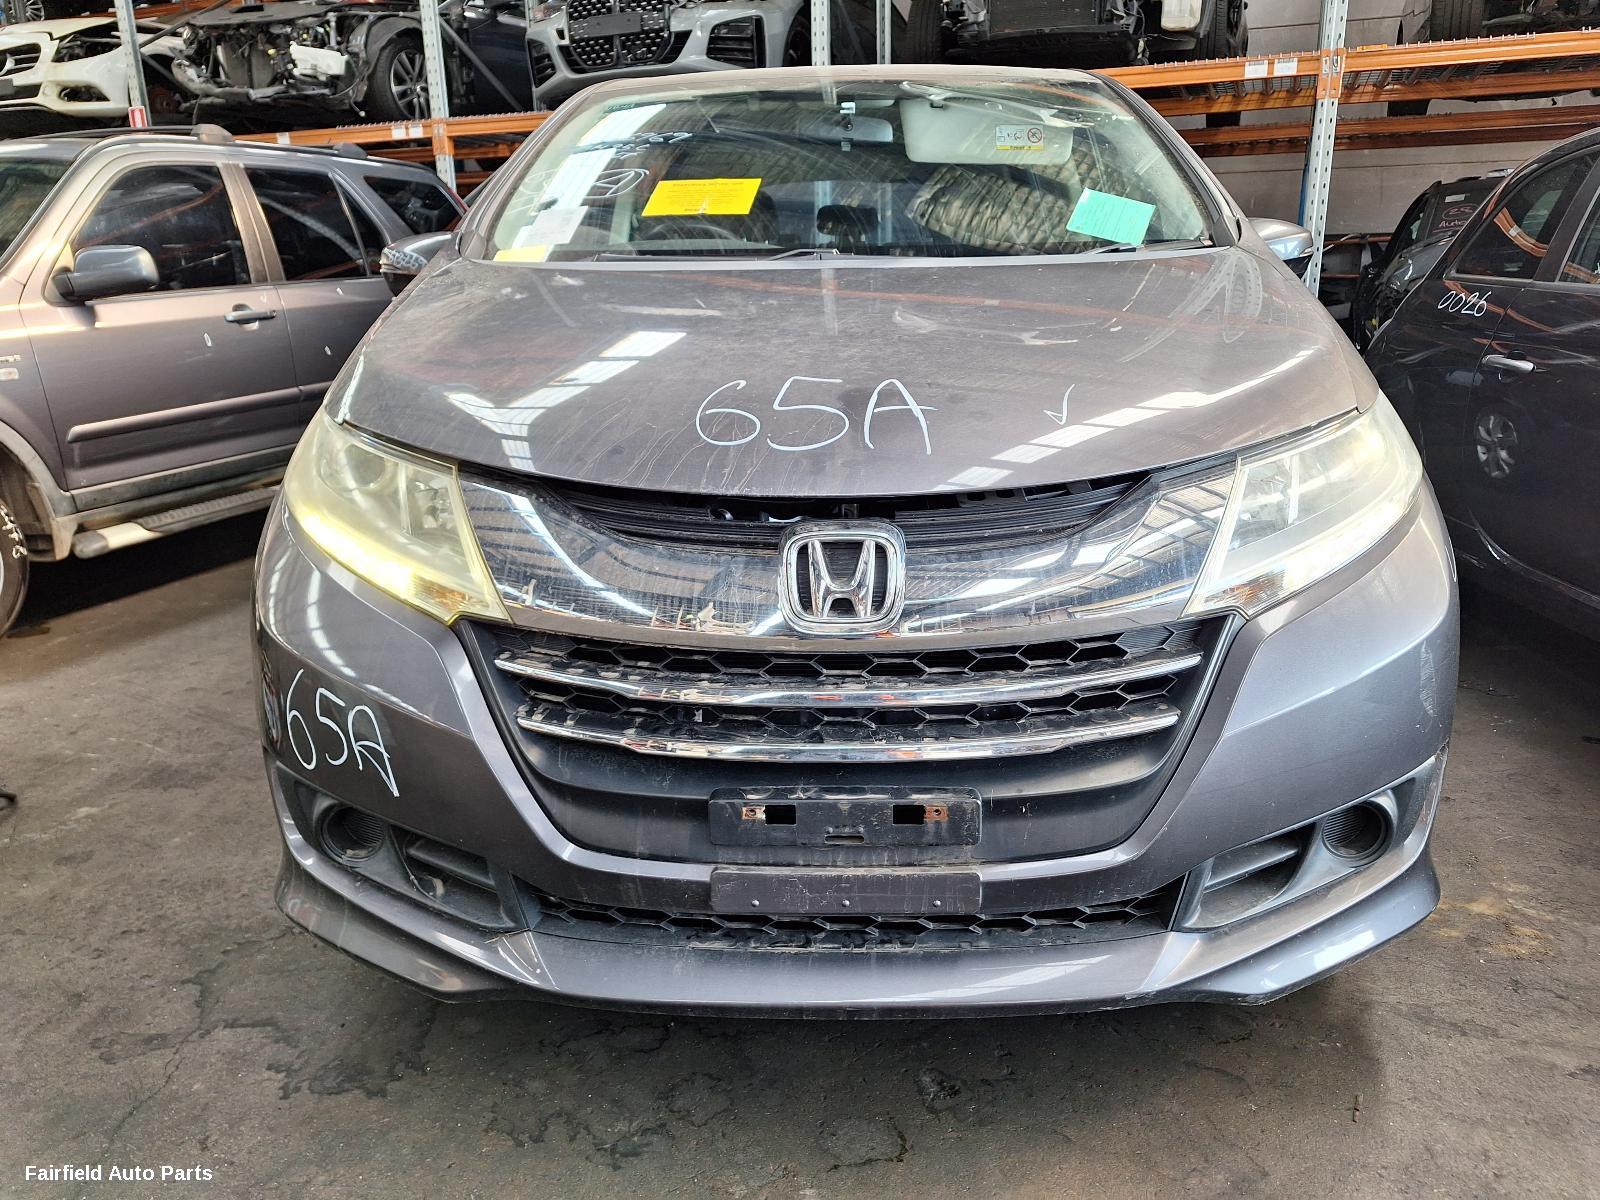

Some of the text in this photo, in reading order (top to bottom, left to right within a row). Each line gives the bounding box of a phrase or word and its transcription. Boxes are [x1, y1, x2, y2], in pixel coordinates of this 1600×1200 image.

[1437, 290, 1492, 317] 0026
[695, 375, 939, 456] 65A
[286, 668, 400, 797] 65A
